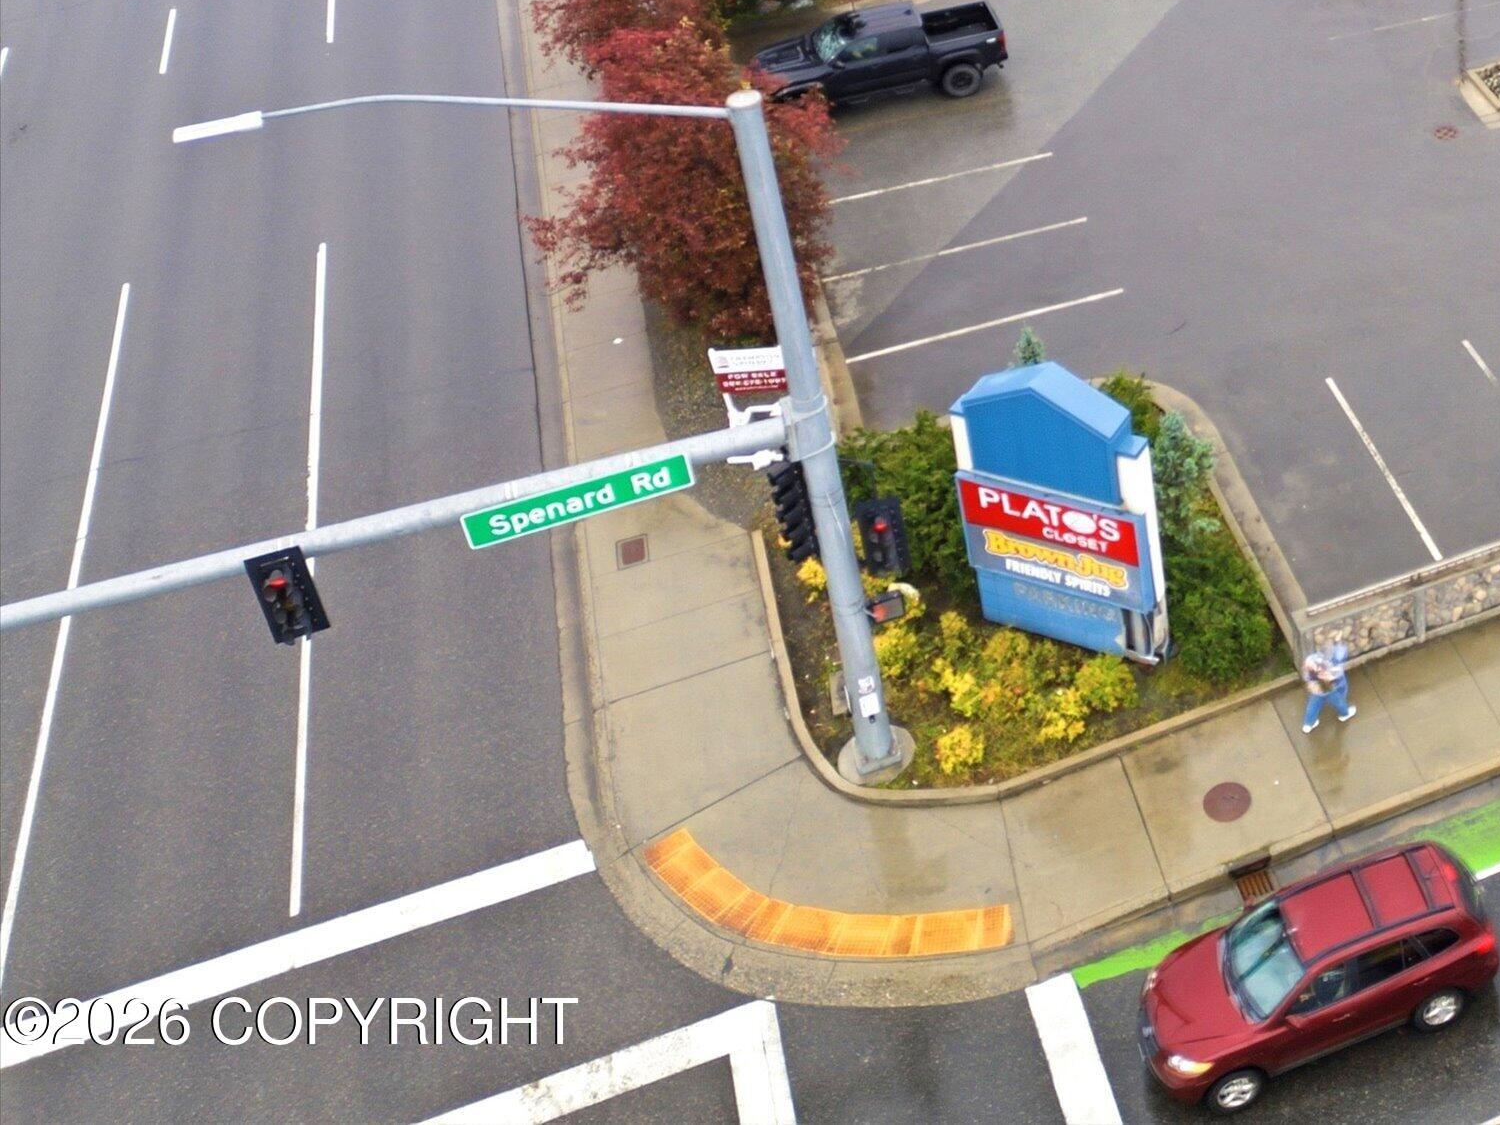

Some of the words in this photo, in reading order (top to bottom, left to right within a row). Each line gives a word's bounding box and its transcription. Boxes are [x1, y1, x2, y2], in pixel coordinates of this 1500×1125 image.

[488, 483, 617, 536] Spenard
[630, 466, 672, 495] Rd
[977, 486, 1121, 542] PLATO'S
[1042, 527, 1109, 553] CLOSET
[1005, 558, 1063, 584] FRIENDLY
[1064, 574, 1112, 597] SPIRITS
